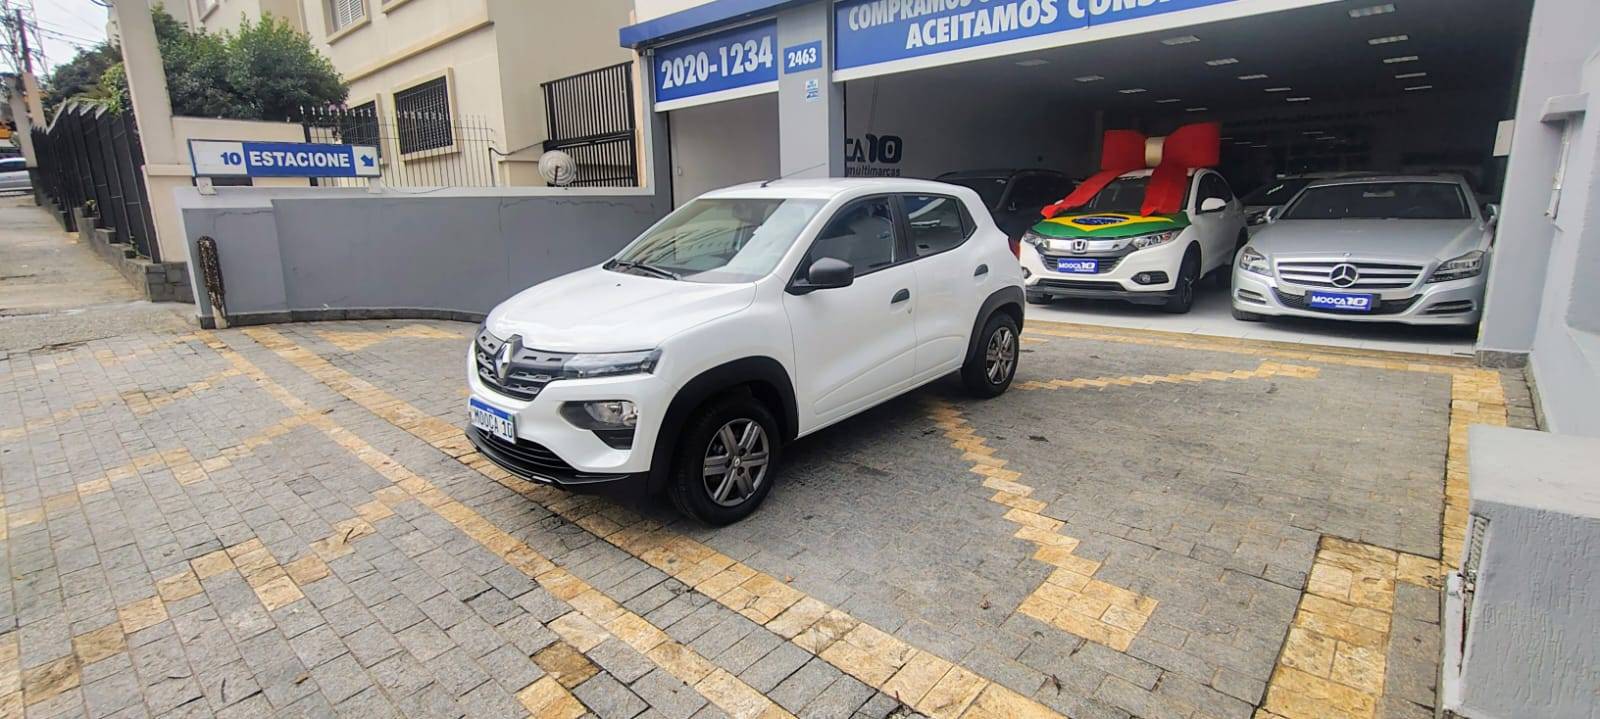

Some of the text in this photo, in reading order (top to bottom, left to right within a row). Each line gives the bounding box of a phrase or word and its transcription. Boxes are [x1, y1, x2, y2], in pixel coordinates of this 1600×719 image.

[849, 0, 970, 31] COMPRAM
[905, 0, 1058, 50] ACEITAMOS
[661, 36, 772, 89] 2020-1234
[788, 47, 817, 68] 2463
[220, 151, 350, 168] 10 ESTACIONE
